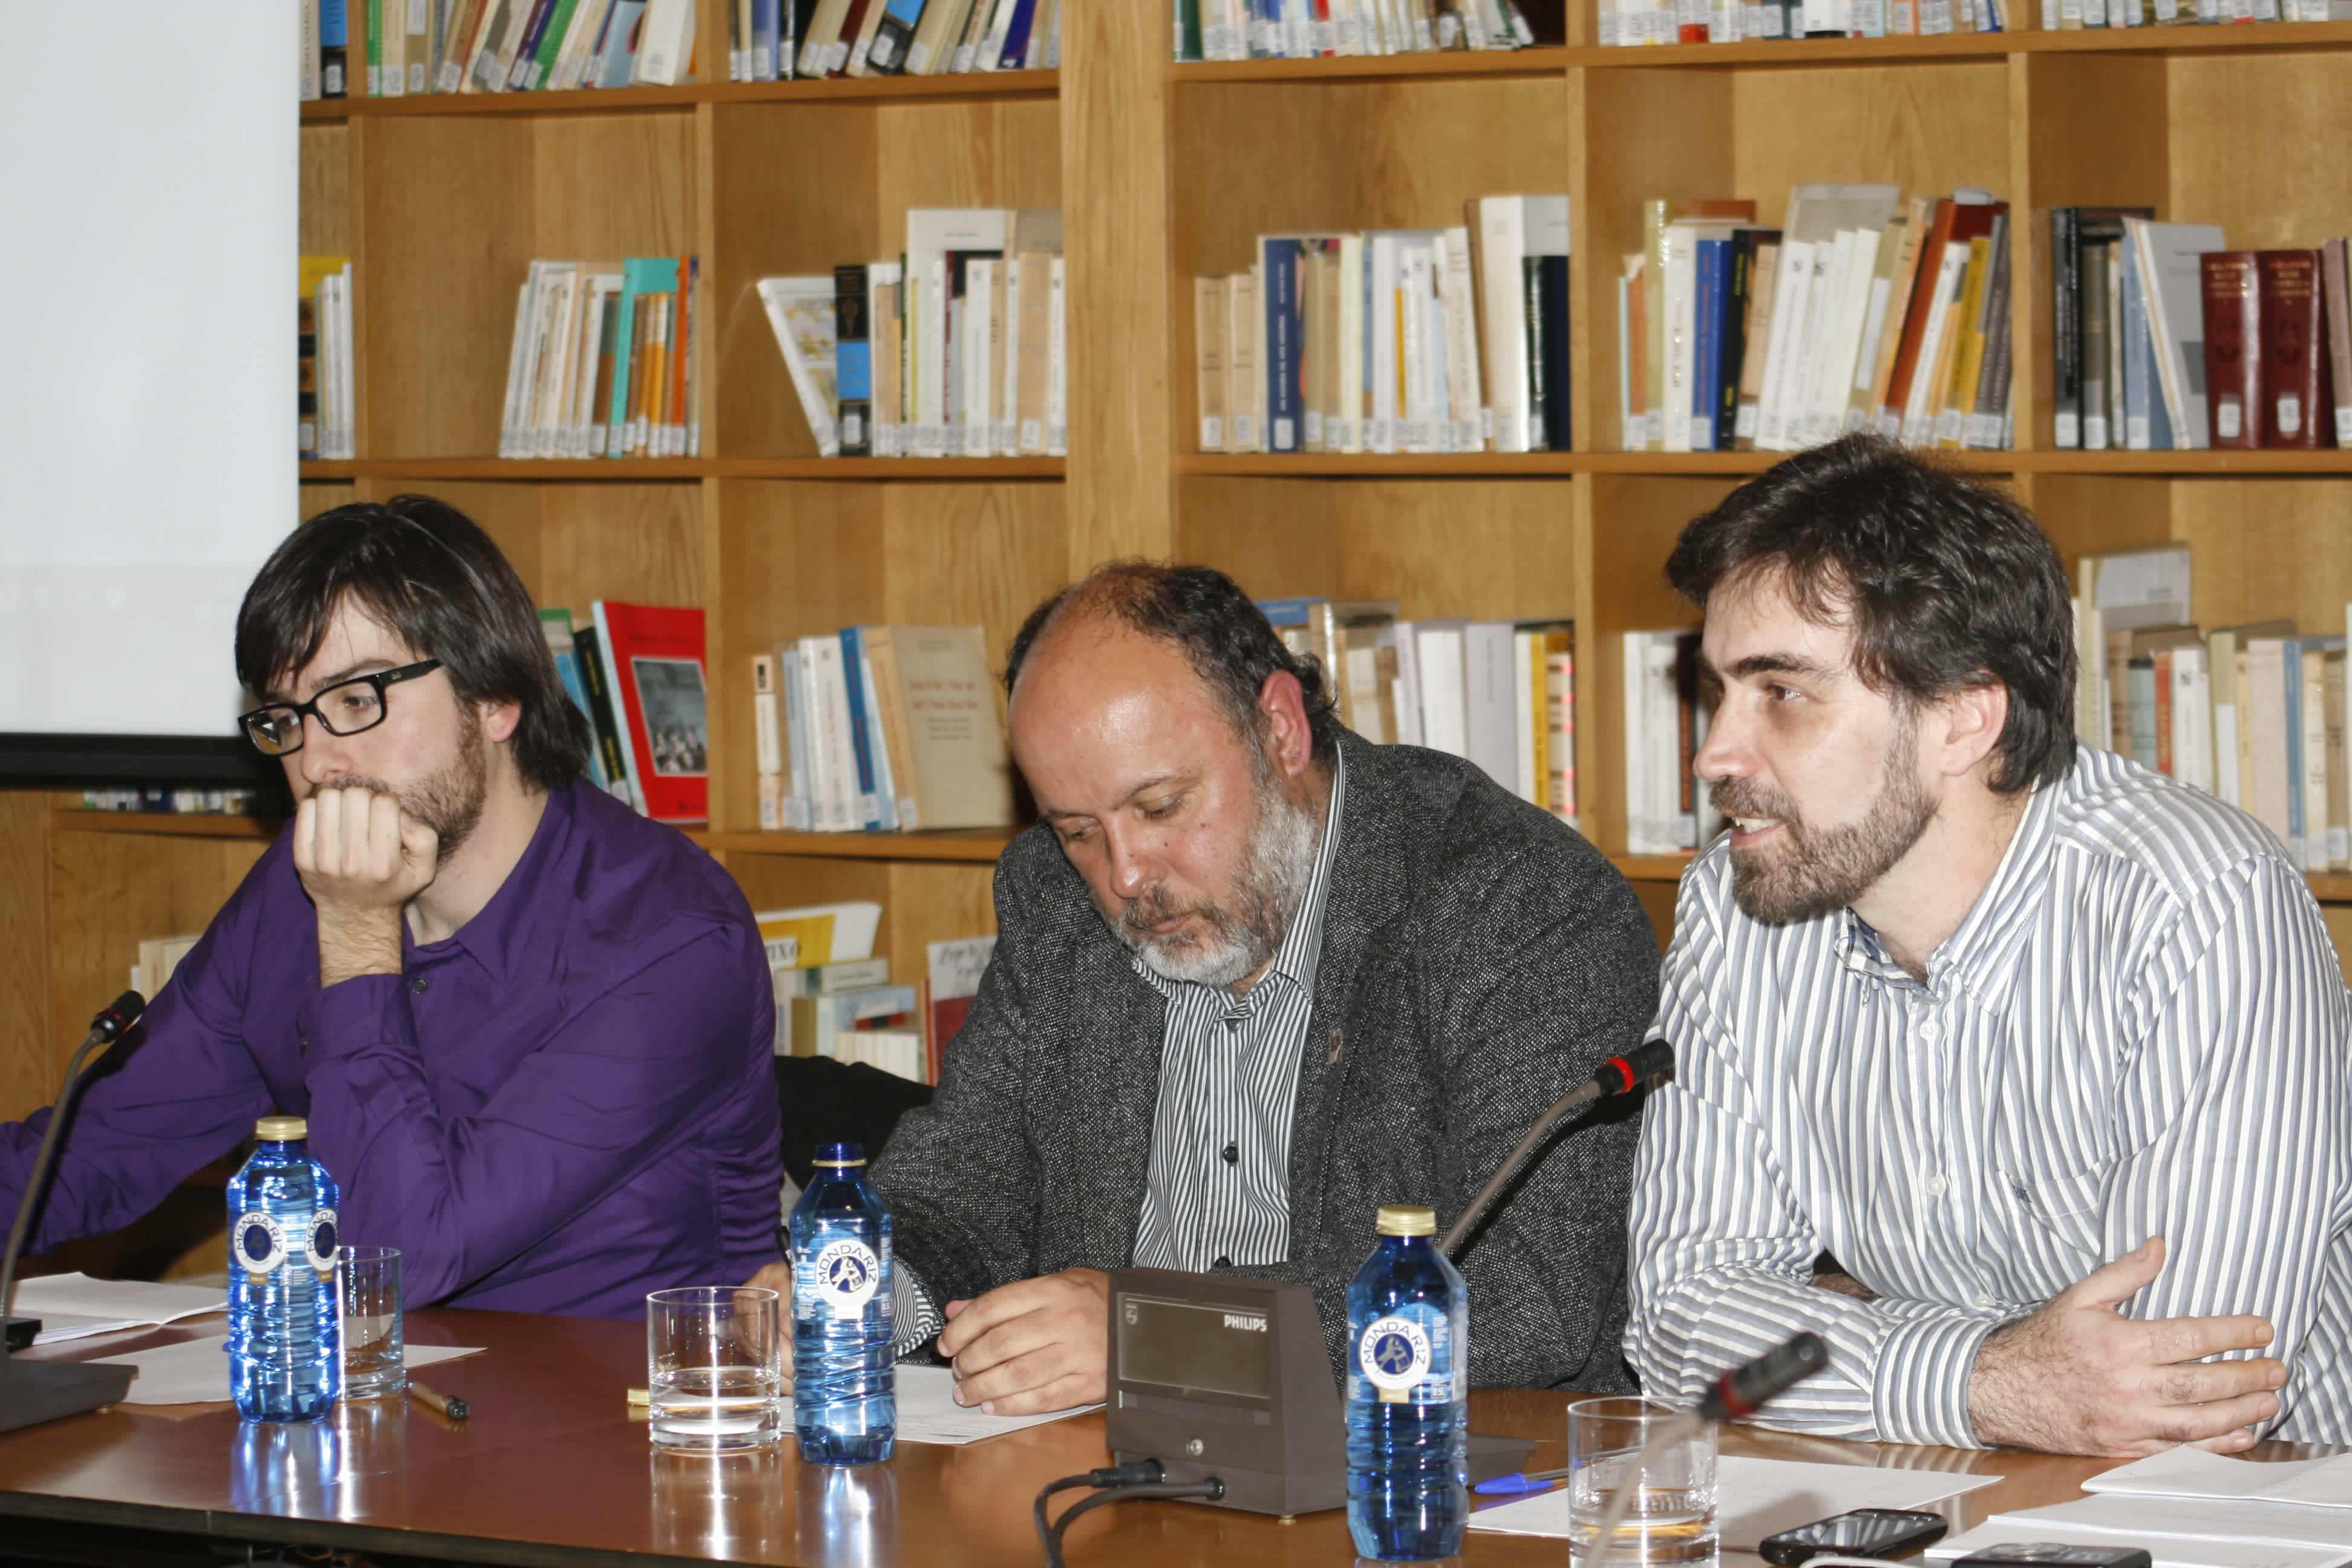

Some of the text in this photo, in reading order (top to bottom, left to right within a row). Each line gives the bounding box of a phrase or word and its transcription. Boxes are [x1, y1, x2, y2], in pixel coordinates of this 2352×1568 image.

[235, 1214, 281, 1253] MONDARIZ
[818, 1244, 877, 1284] MONDARIZ
[1224, 1314, 1268, 1333] PHILIPS
[1364, 1321, 1426, 1365] MONDARIZ
